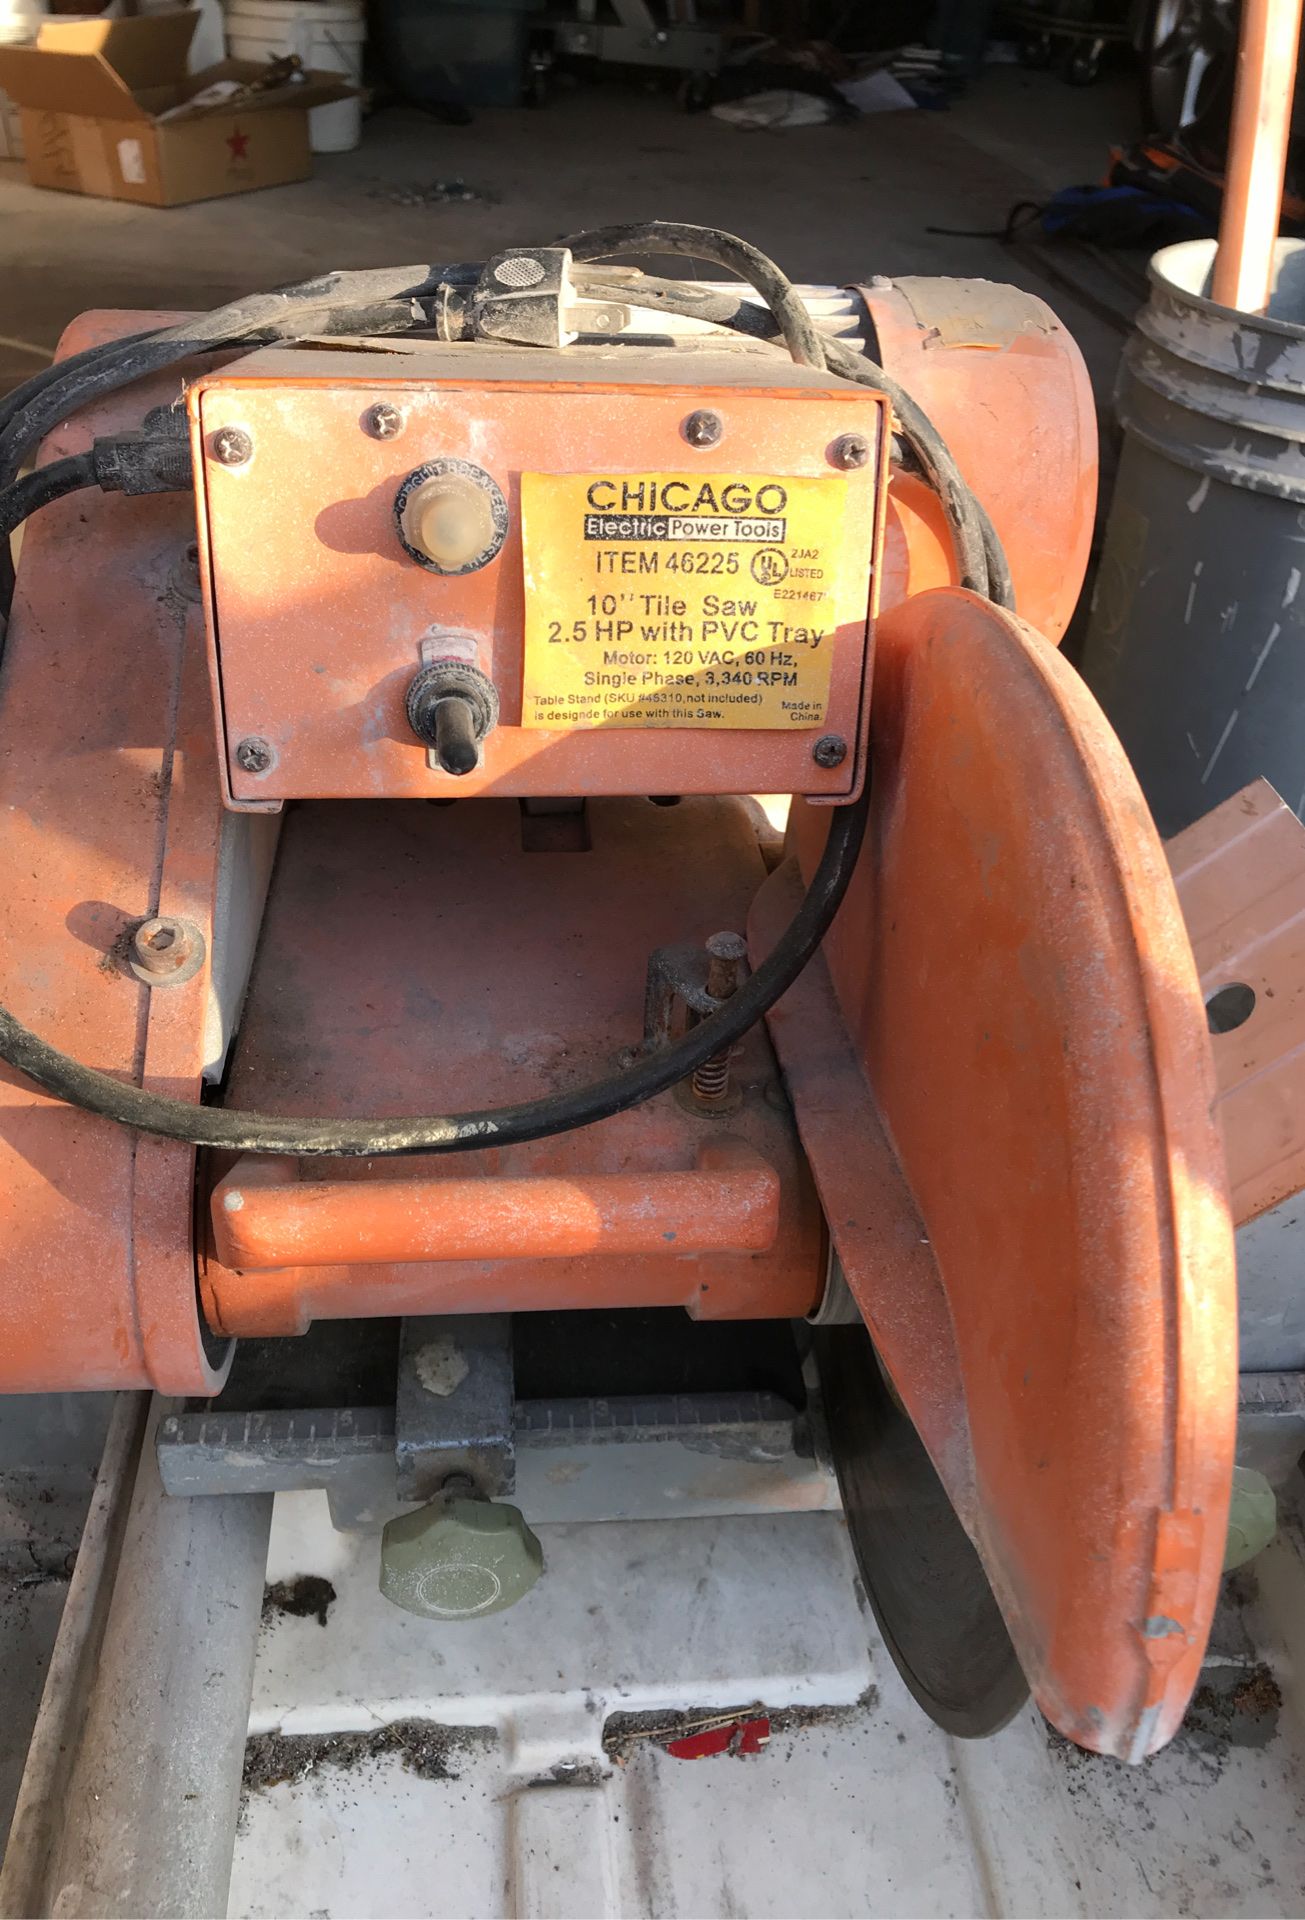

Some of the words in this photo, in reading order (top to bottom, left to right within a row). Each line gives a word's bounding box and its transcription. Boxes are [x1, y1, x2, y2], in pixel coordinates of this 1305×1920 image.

[587, 480, 788, 514] CHICAGO
[586, 517, 667, 537] Electric
[672, 519, 729, 536] Power
[734, 520, 780, 538] Tools
[596, 551, 658, 574] ITEM
[665, 552, 740, 575] 46225
[789, 567, 824, 579] LISTED
[640, 595, 687, 616] Tile
[702, 595, 758, 617] Saw
[548, 620, 588, 643] 2.5
[595, 621, 634, 642] HP
[641, 622, 694, 643] with
[702, 621, 760, 643] PVC
[768, 621, 825, 649] Tray
[603, 650, 657, 665] Motor:
[664, 651, 693, 665] 120
[699, 651, 740, 667] VAC,
[744, 651, 765, 665] 60
[771, 651, 798, 668] Hz,
[584, 671, 637, 688] Single
[642, 671, 700, 688] Phase,
[705, 671, 751, 687] 3,340
[757, 671, 798, 686] RPM
[534, 694, 565, 705] Table
[567, 694, 601, 705] Stand
[604, 693, 635, 706] (SKU
[686, 694, 705, 704] not
[708, 694, 763, 706] included)
[781, 701, 811, 711] Made
[812, 701, 822, 710] in
[534, 710, 544, 720] is
[603, 709, 618, 719] for
[621, 710, 643, 719] use
[646, 709, 670, 719] with
[672, 709, 694, 719] this
[696, 709, 725, 719] Saw.
[790, 711, 823, 722] China.
